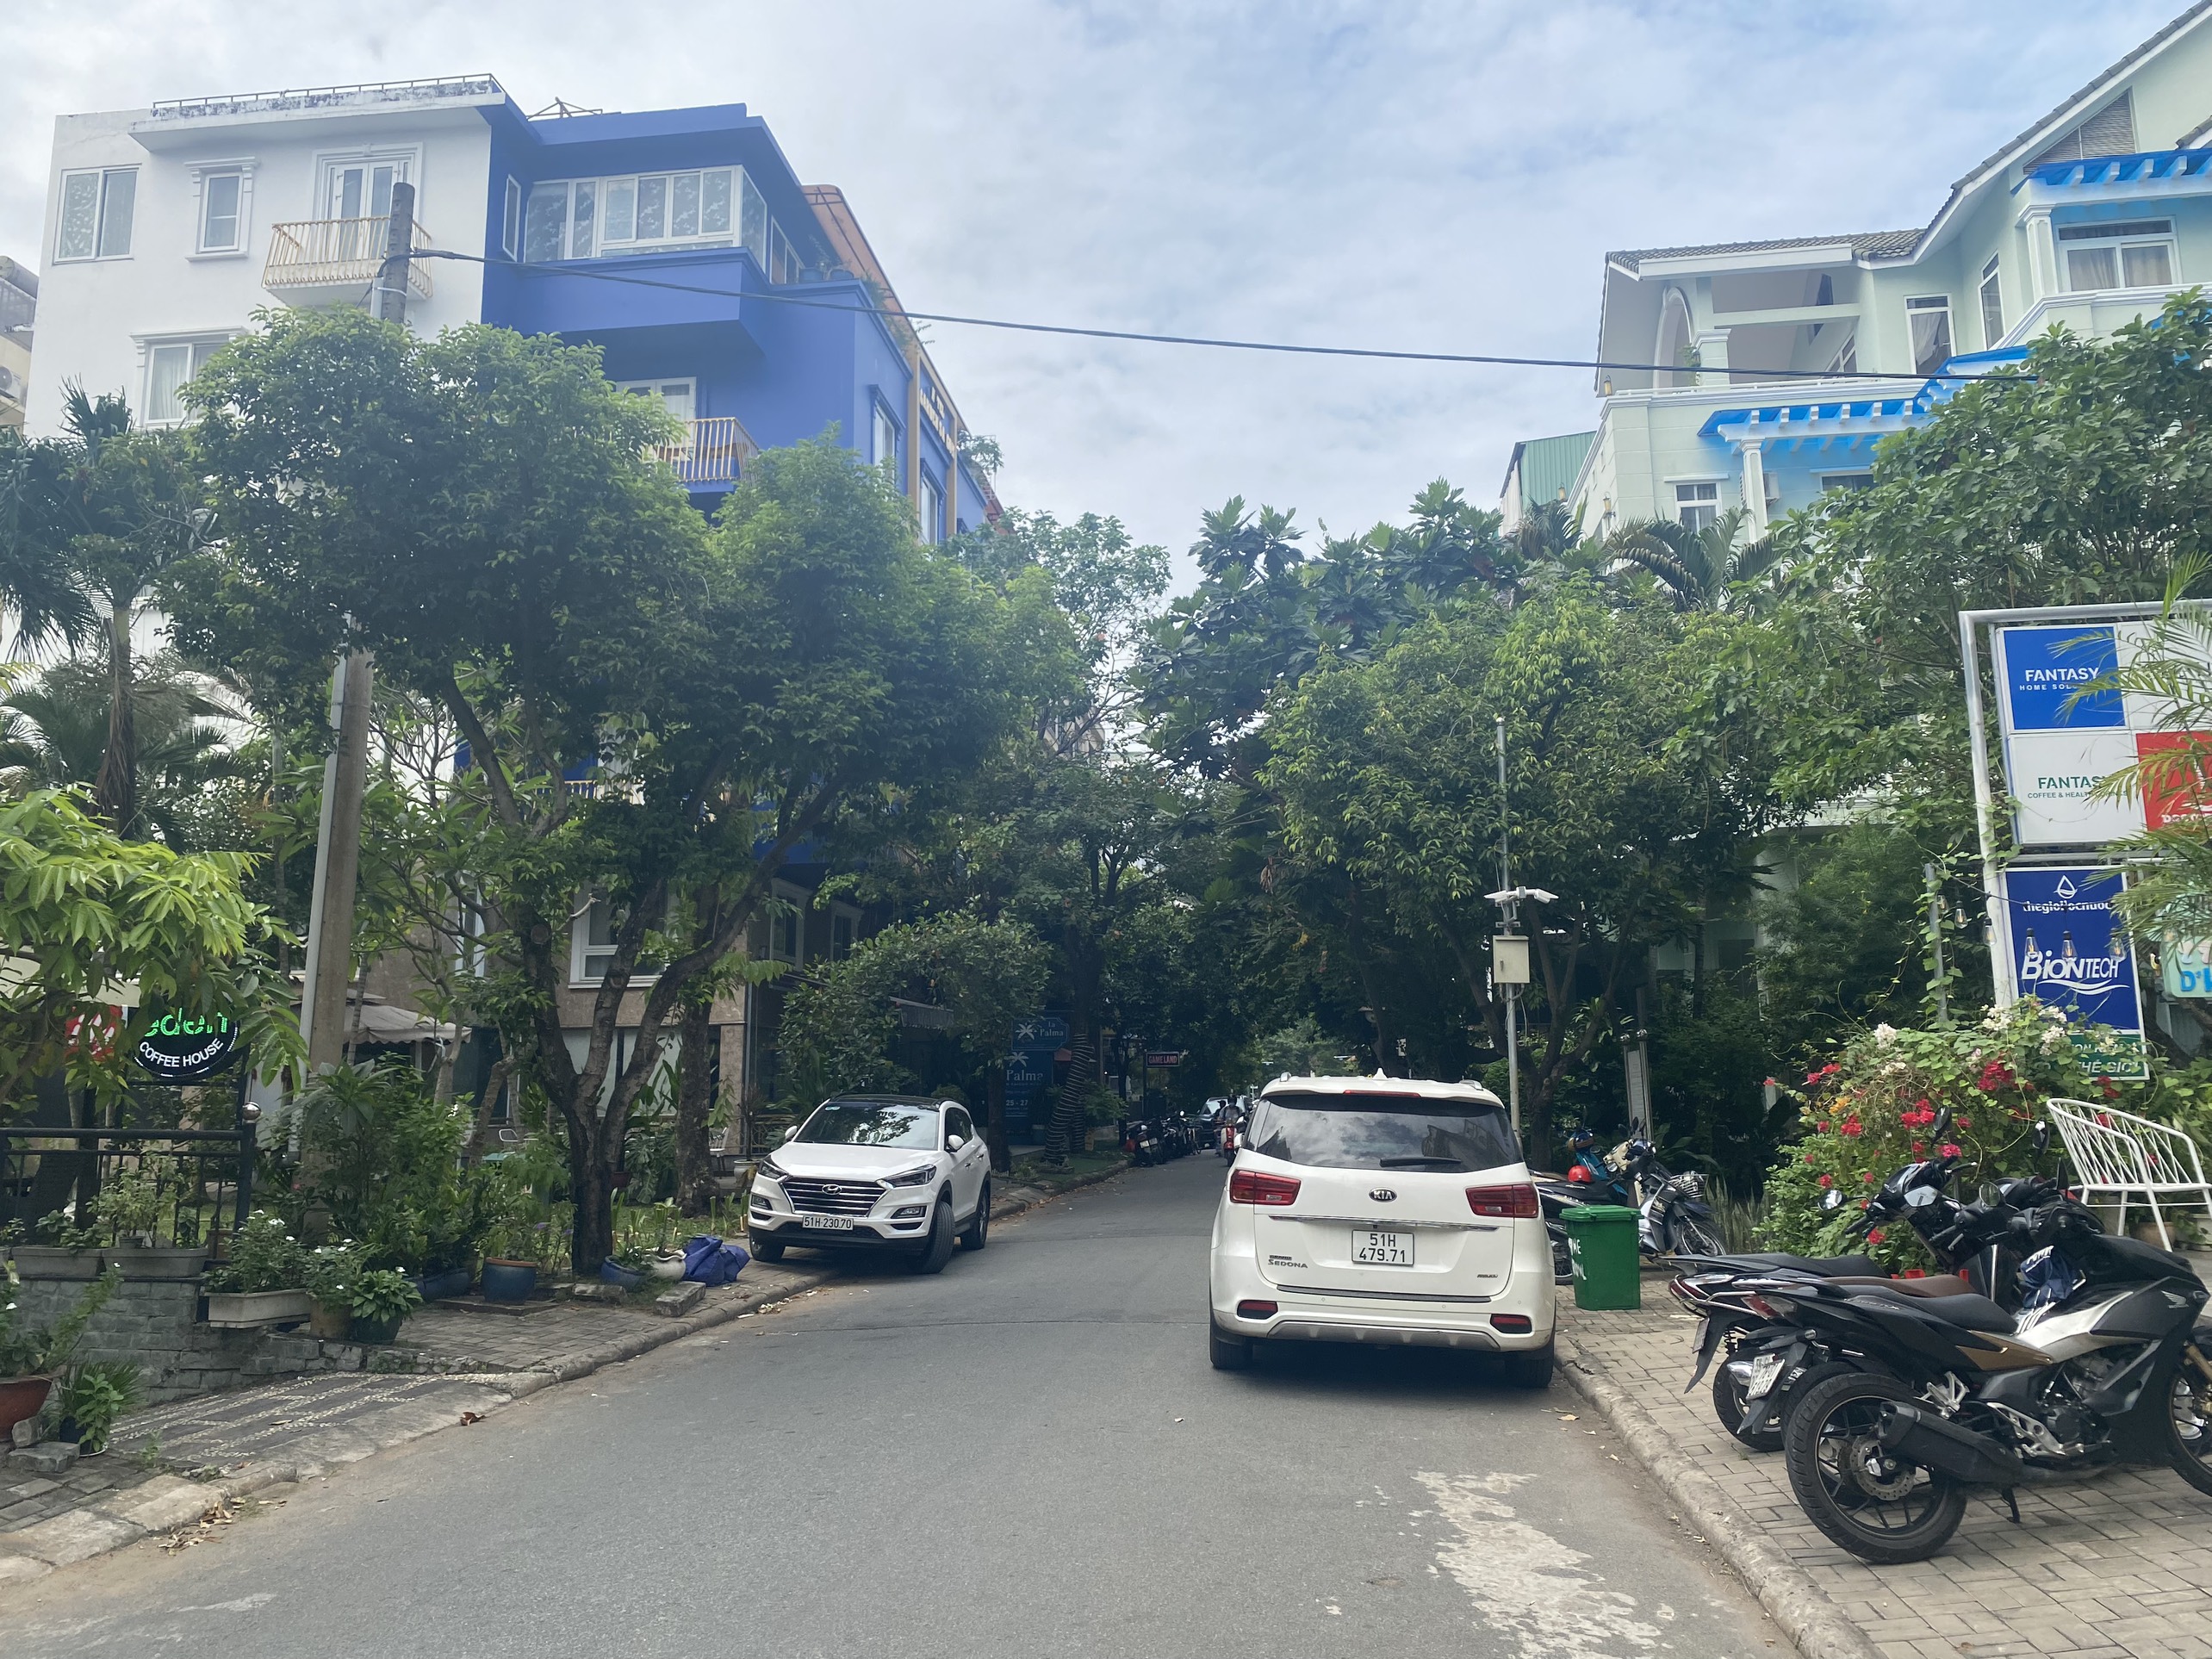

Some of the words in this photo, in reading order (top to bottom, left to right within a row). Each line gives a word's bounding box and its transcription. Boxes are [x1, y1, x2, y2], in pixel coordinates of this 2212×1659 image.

[2025, 667, 2099, 681] FANTASY
[1040, 1028, 1064, 1037] Palma
[140, 1041, 180, 1067] COFFEE
[183, 1037, 224, 1066] HOUSE
[1373, 1190, 1393, 1200] KIA
[1370, 1233, 1396, 1247] 51H
[1358, 1246, 1406, 1263] 479.71
[1267, 1258, 1308, 1269] SEDONA
